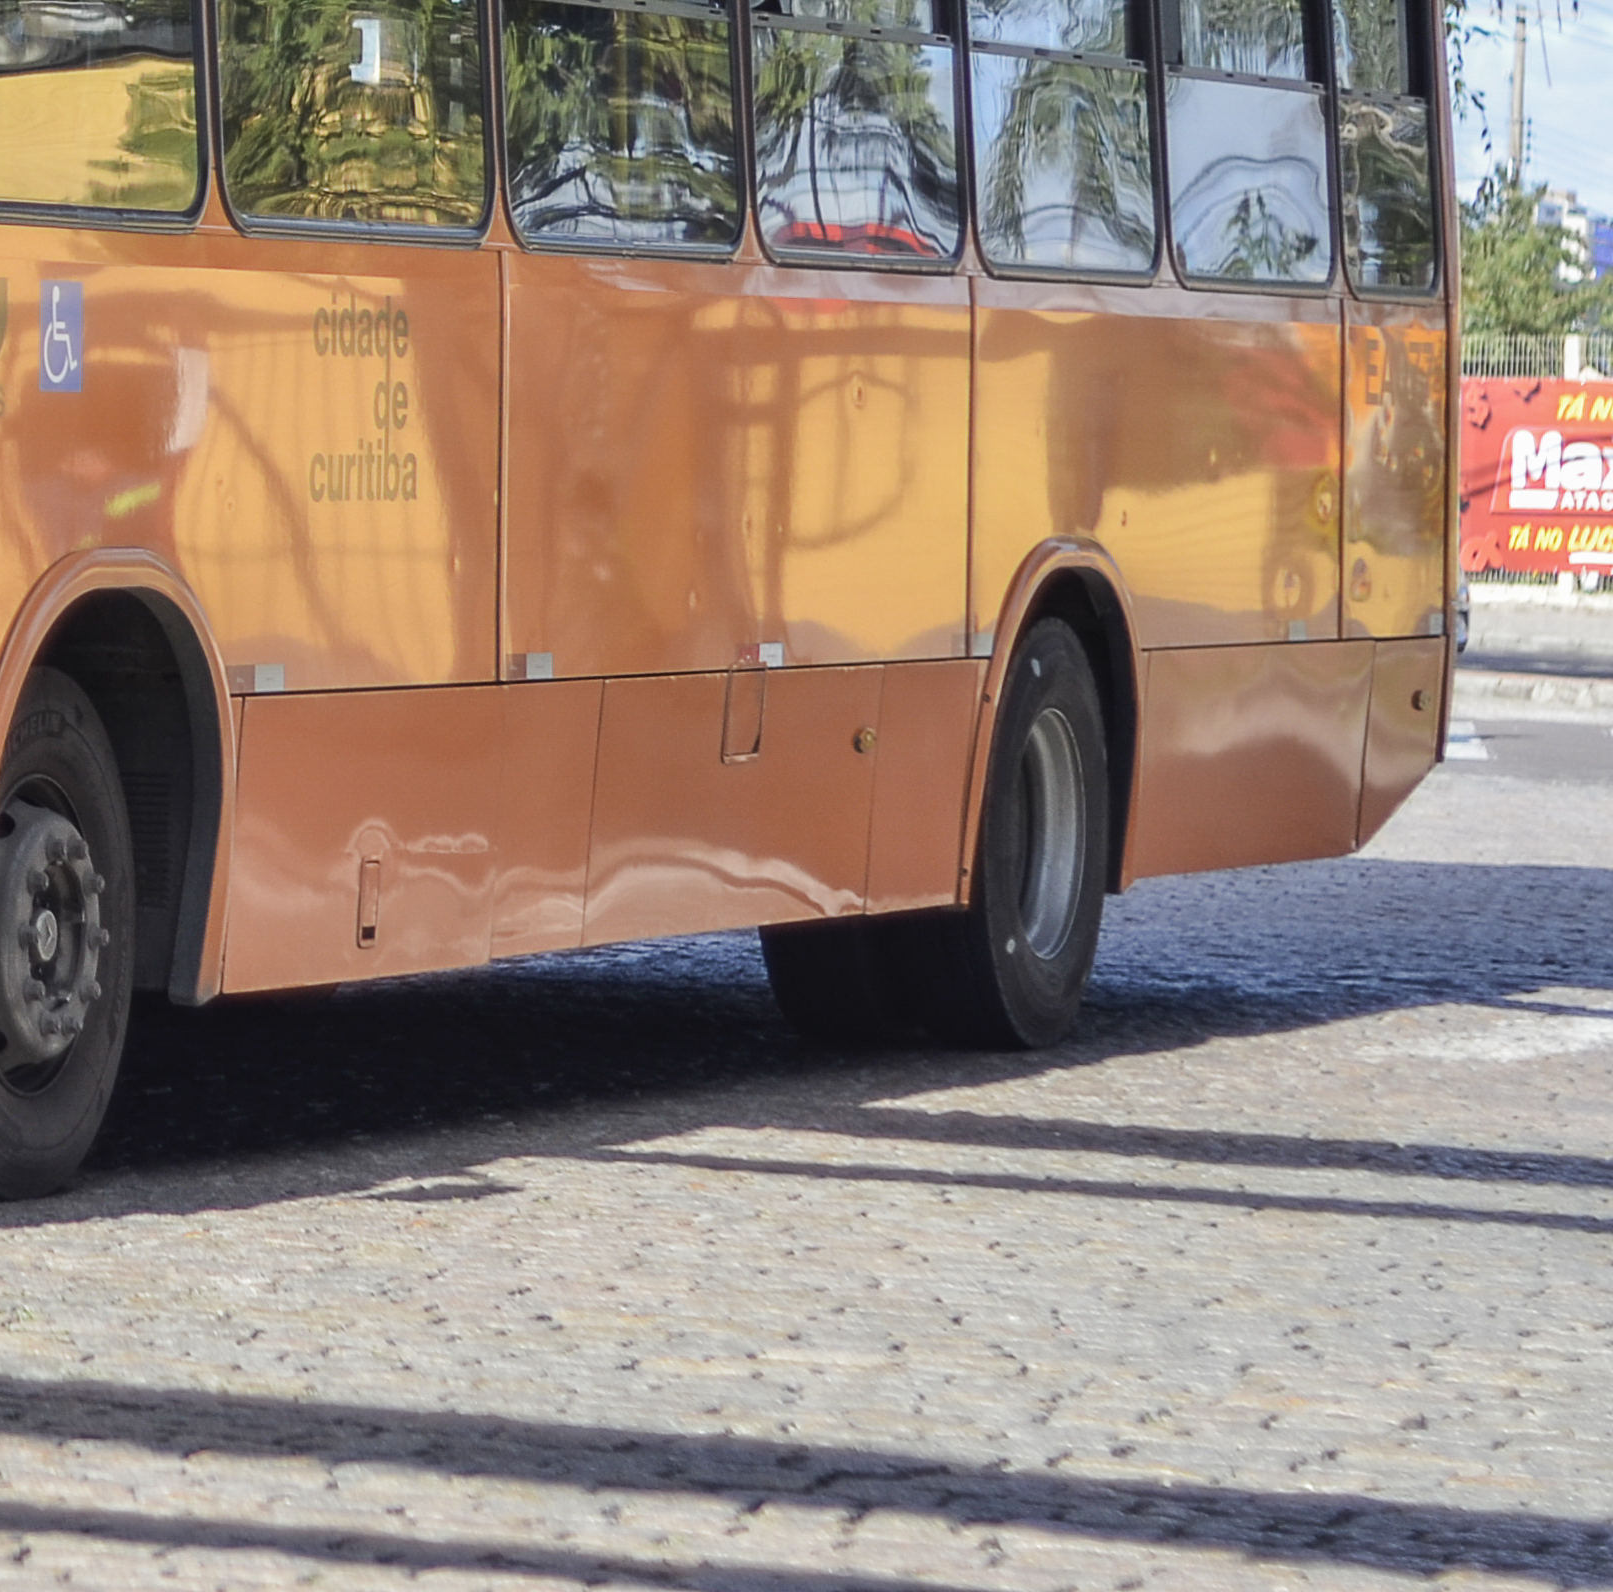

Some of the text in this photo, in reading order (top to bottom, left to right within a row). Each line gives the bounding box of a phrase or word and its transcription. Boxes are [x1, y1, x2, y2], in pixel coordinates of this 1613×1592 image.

[313, 294, 409, 357] cidade
[373, 365, 409, 430] de
[1556, 391, 1613, 422] TÁ N
[308, 441, 418, 503] curitiba
[1508, 523, 1531, 551] TÁ
[1534, 525, 1563, 552] NO
